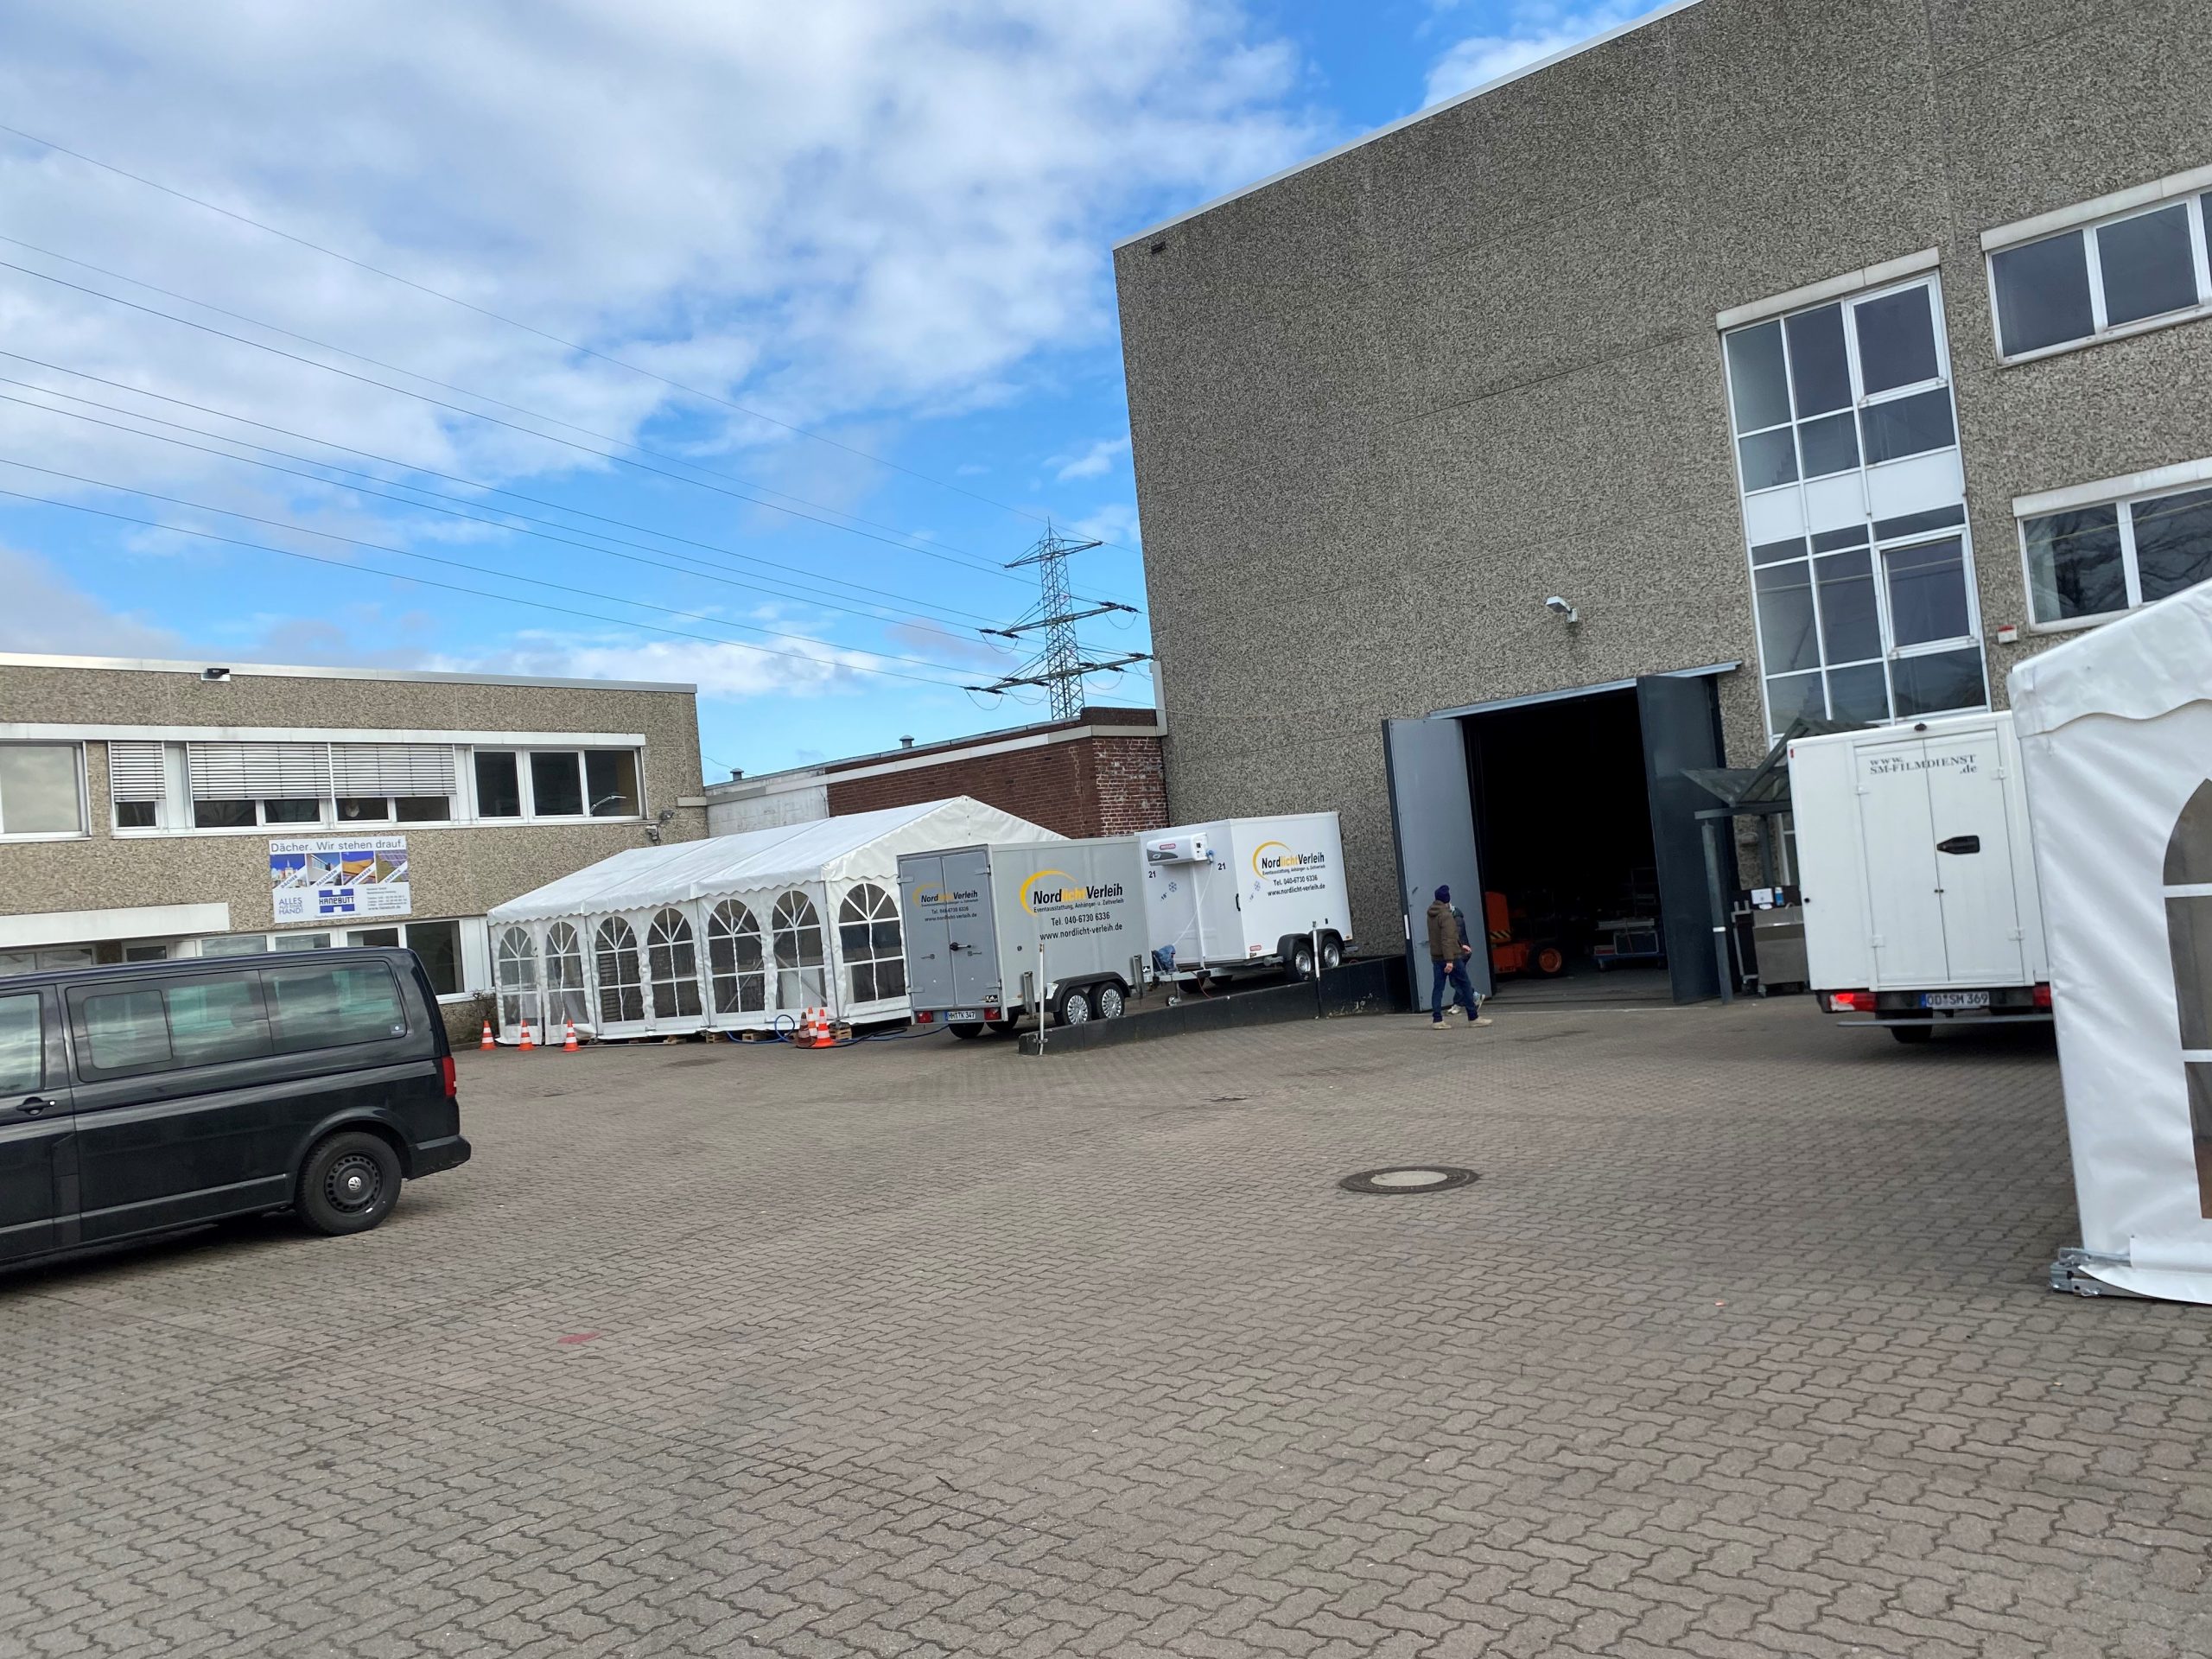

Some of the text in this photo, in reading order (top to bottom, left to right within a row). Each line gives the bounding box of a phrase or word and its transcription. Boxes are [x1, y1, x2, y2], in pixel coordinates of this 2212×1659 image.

[1870, 754, 1976, 774] SM-FILMDIENST
[270, 839, 404, 853] Dächer. Wir stehen drauf.
[316, 869, 337, 887] FASSADEN
[1051, 912, 1110, 925] Tel. 040-6730 6336
[1039, 923, 1122, 940] www.nordlicht-verleih.de
[1967, 994, 1987, 1004] 369
